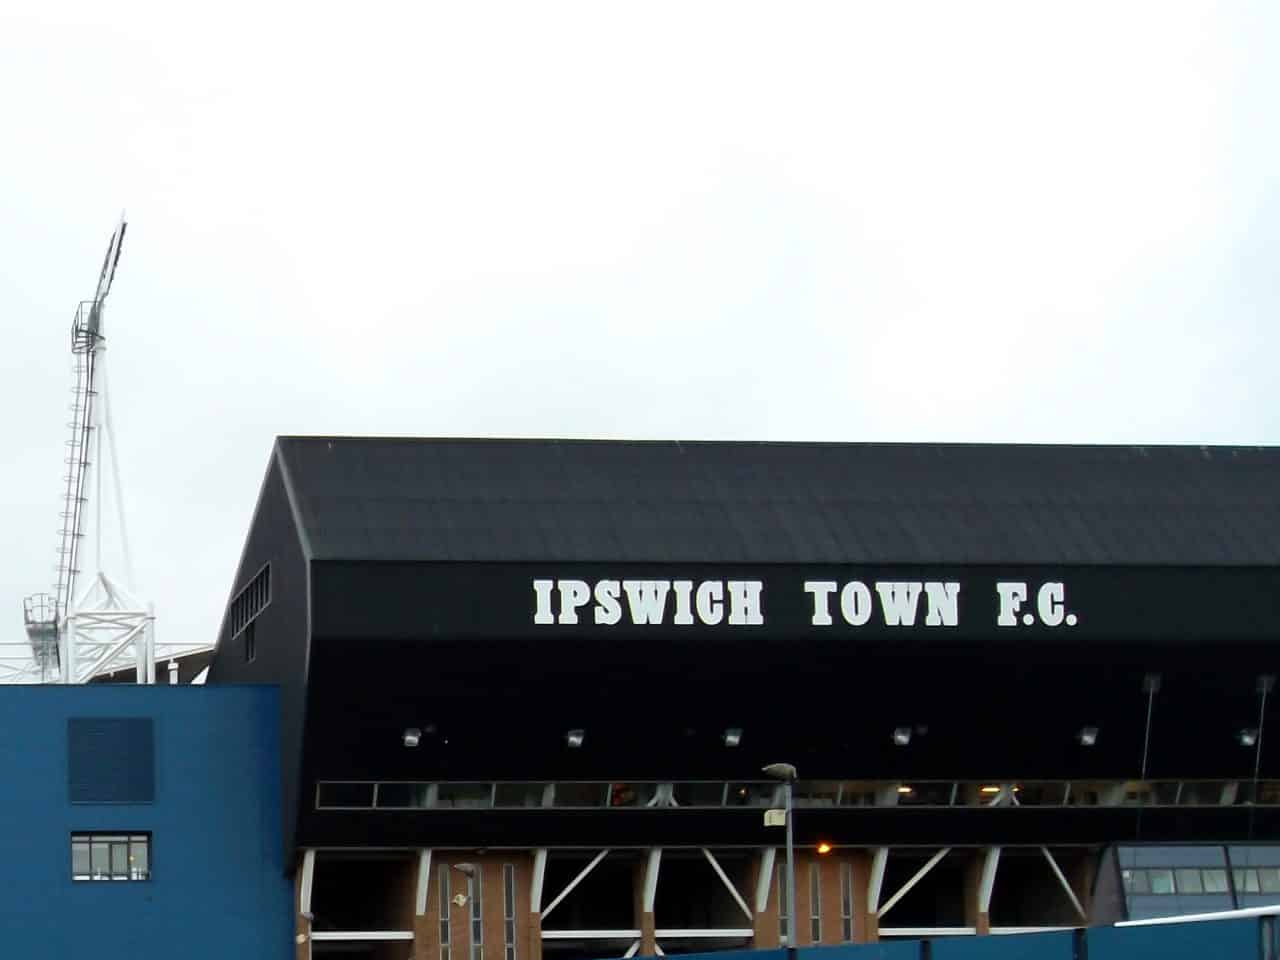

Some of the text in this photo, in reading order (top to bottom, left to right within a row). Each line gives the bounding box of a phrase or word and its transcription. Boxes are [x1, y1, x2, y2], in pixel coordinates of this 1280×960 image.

[533, 580, 1078, 626] IPSWICH TOWN F.C.
